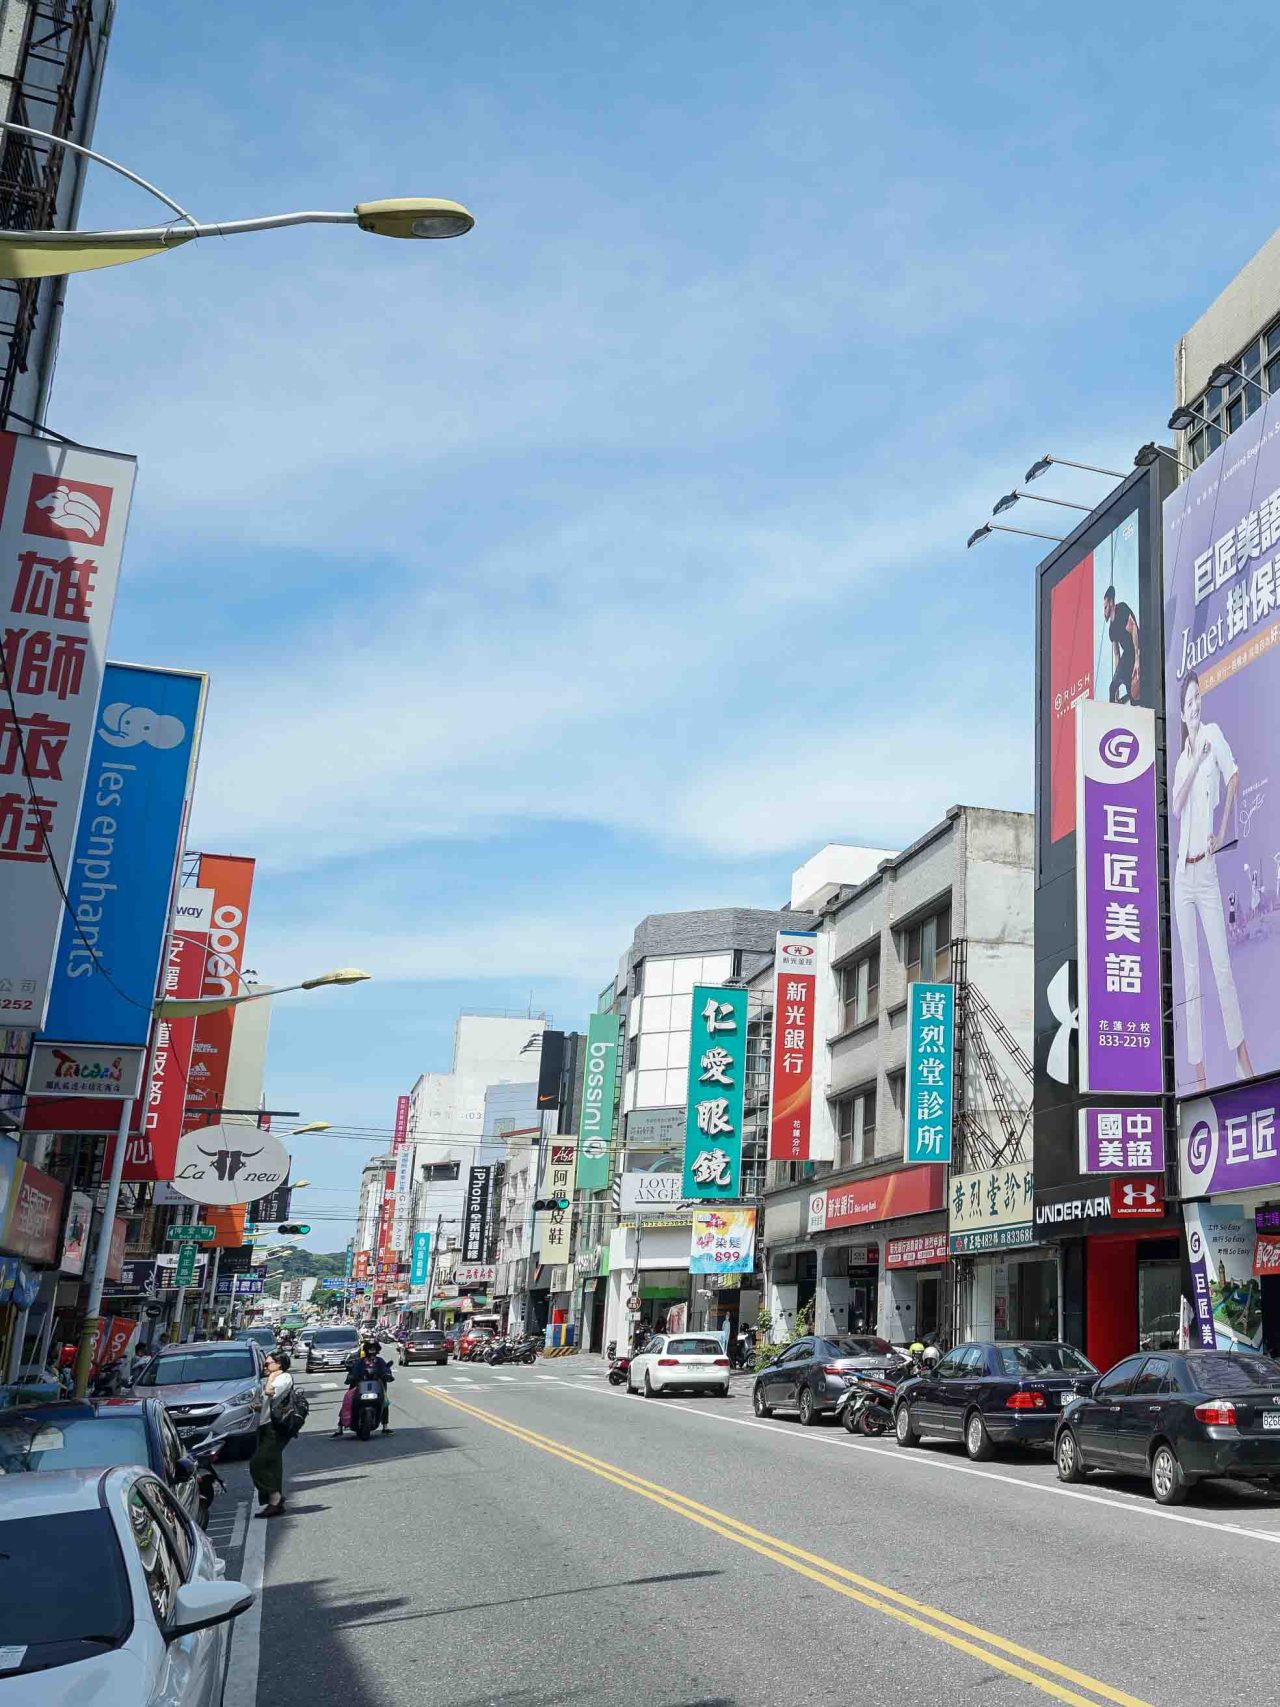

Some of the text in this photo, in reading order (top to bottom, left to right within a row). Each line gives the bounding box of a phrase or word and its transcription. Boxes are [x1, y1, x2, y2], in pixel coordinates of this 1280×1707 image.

[1176, 614, 1225, 679] Janet
[1063, 672, 1090, 700] RUSH
[66, 761, 137, 978] les enphants
[1103, 804, 1142, 994] 巨匠美語
[782, 981, 808, 1074] 新光銀行
[1098, 1020, 1151, 1033] 花蓮分校
[1098, 1034, 1151, 1048] 833-2219
[584, 1042, 615, 1130] bossini
[691, 998, 738, 1188] 仁愛眼鏡
[916, 991, 946, 1155] 黃烈堂診所
[1097, 1113, 1152, 1139] 國中
[1098, 1140, 1152, 1168] 美語
[470, 1168, 486, 1212] iPhone
[639, 1178, 680, 1189] LOVE
[1036, 1200, 1082, 1224] UNDER
[714, 1251, 741, 1263] 899
[1194, 1273, 1214, 1345] 巨匠美
